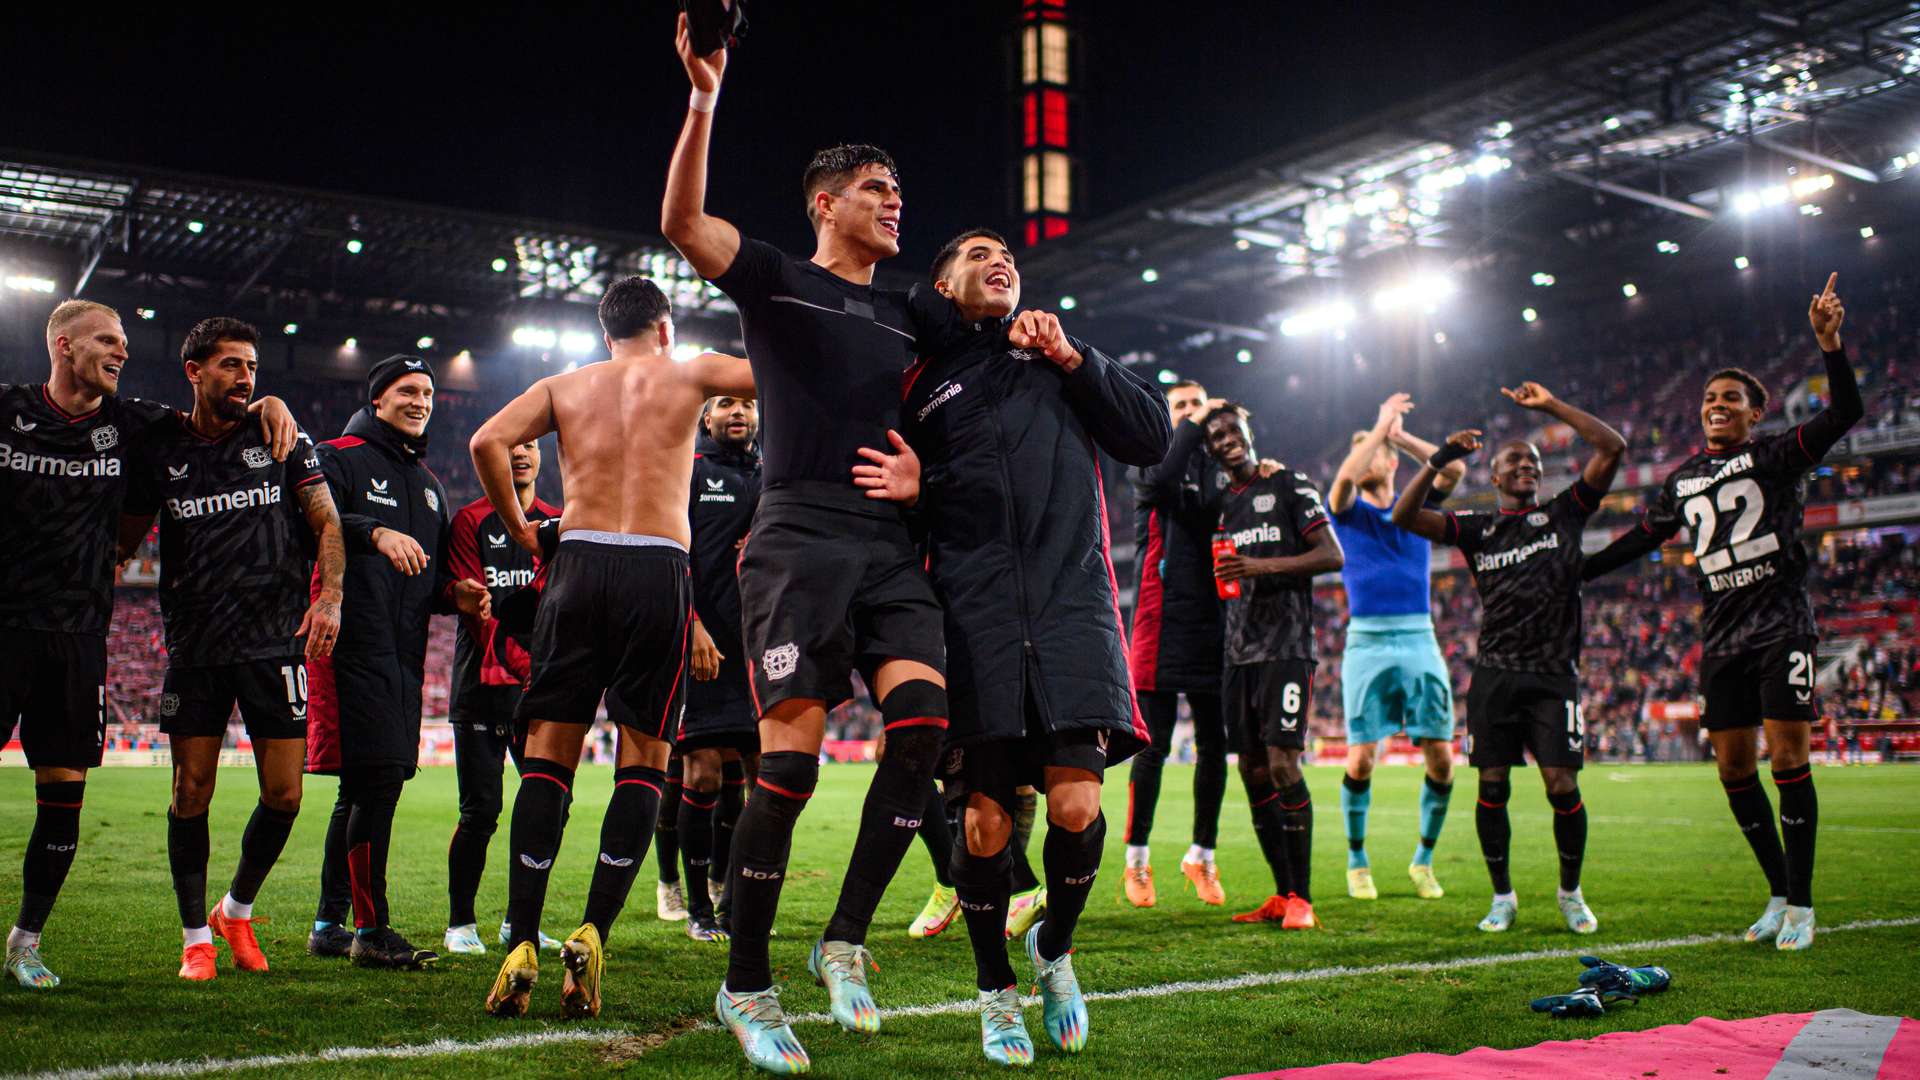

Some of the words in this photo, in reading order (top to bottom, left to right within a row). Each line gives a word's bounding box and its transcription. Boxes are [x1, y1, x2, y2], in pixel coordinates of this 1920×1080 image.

[0, 442, 121, 477] Barmenia
[166, 481, 281, 521] Barmenia
[1231, 521, 1281, 548] menia
[1683, 478, 1780, 576] 22
[483, 566, 536, 588] Barm
[281, 664, 308, 703] 10
[1788, 651, 1814, 688] 21
[1282, 682, 1301, 714] 6
[1565, 700, 1584, 735] 19
